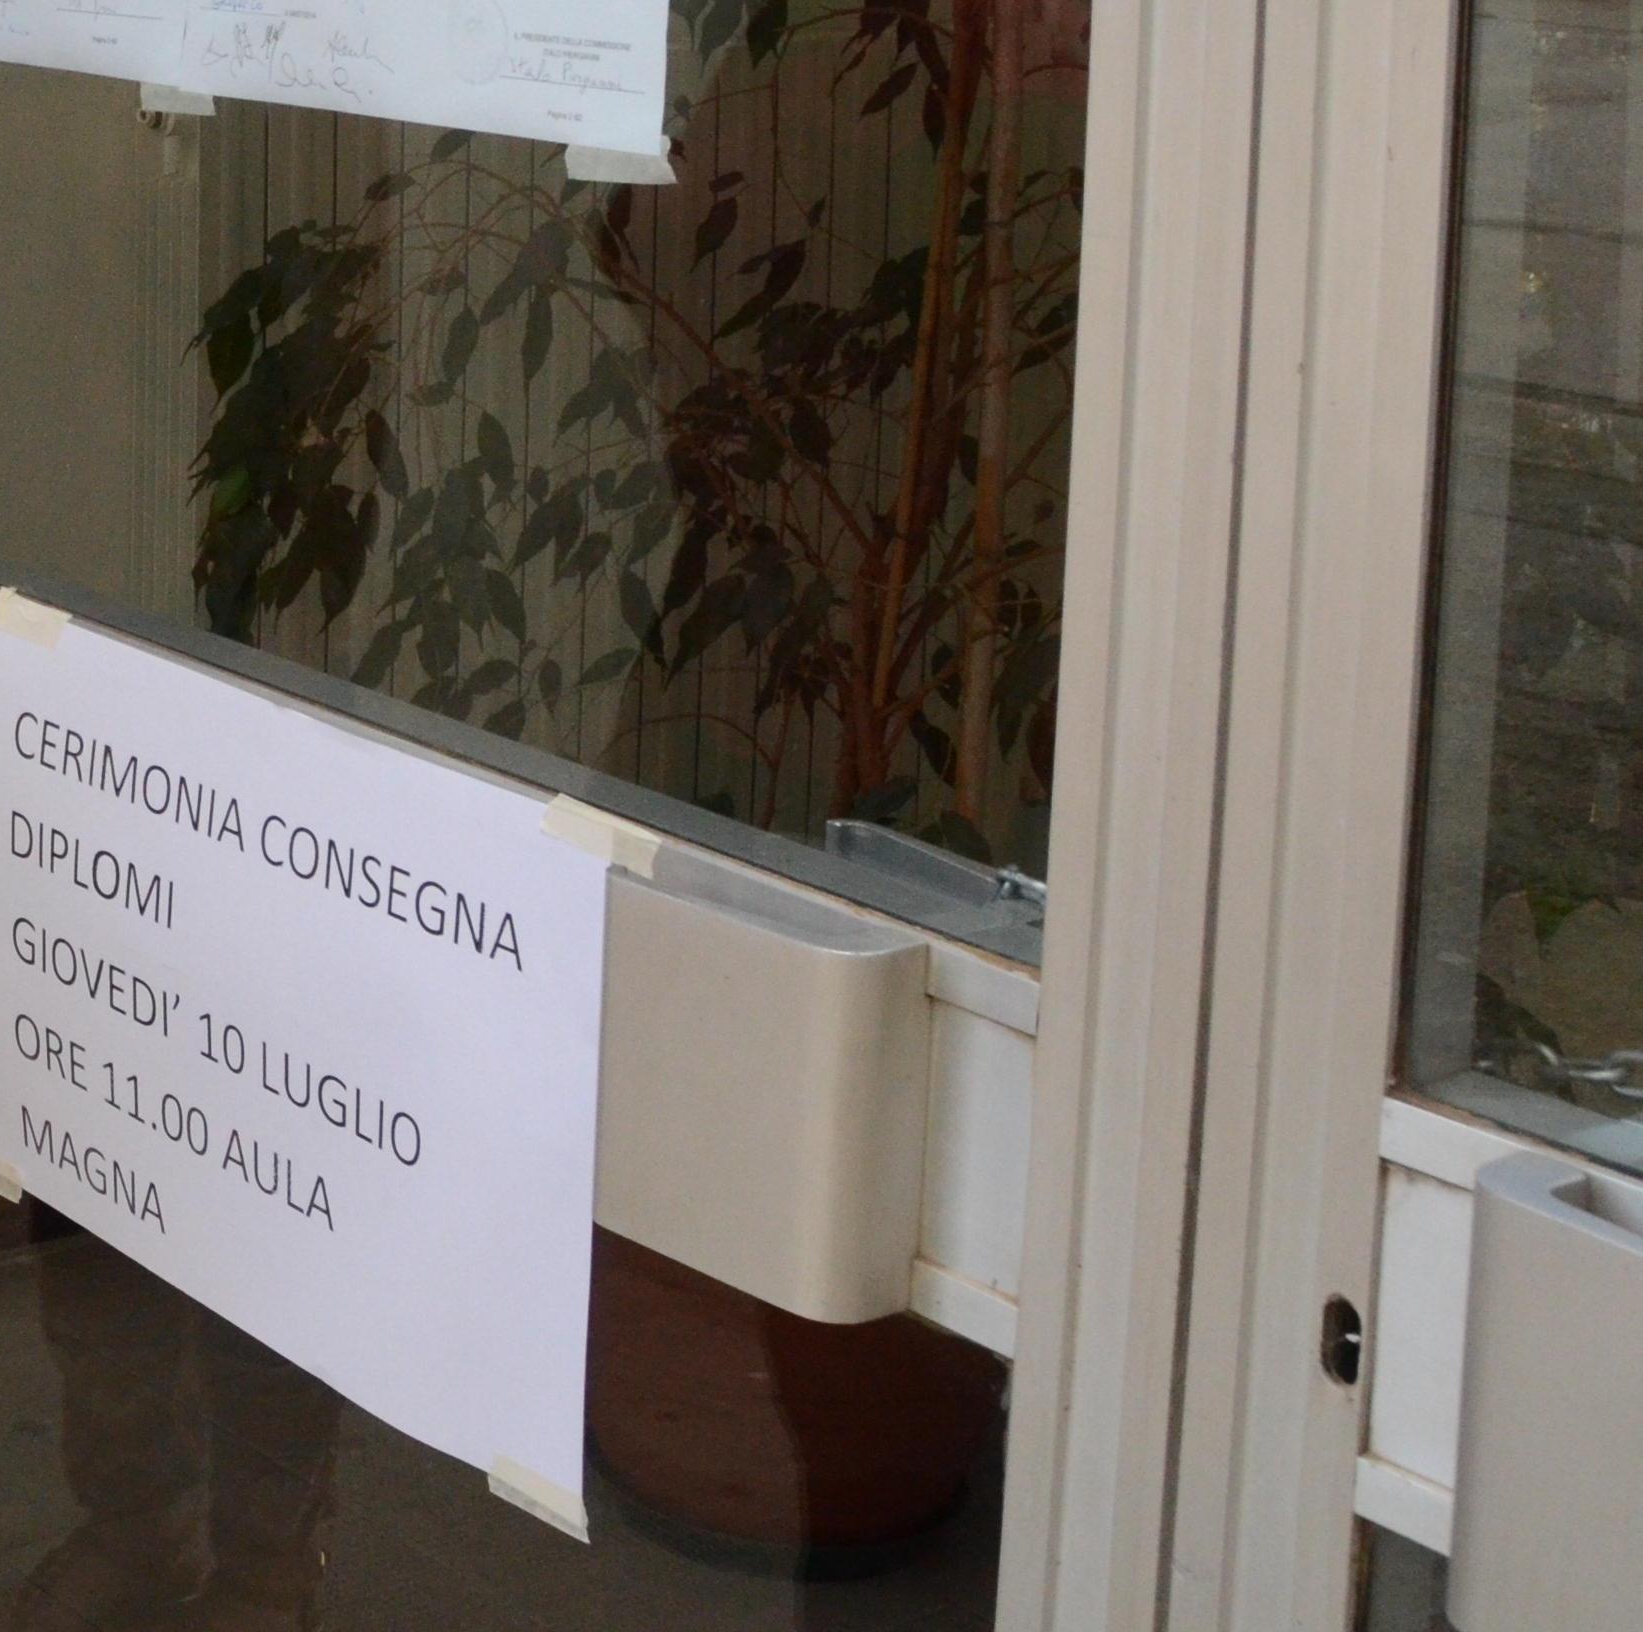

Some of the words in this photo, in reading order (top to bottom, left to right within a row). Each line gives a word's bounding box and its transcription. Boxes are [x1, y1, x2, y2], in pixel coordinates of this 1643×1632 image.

[10, 809, 174, 930] DIPLOMI
[14, 711, 245, 853] CERIMONIA
[260, 814, 523, 973] CONSEGNA
[12, 916, 181, 1038] GIOVEDI'
[198, 1012, 245, 1075] 10
[261, 1041, 421, 1167] LUGLIO
[14, 1013, 88, 1092] ORE
[102, 1061, 209, 1157] 11.00
[221, 1128, 334, 1232] AULA
[21, 1104, 166, 1235] MAGNA
